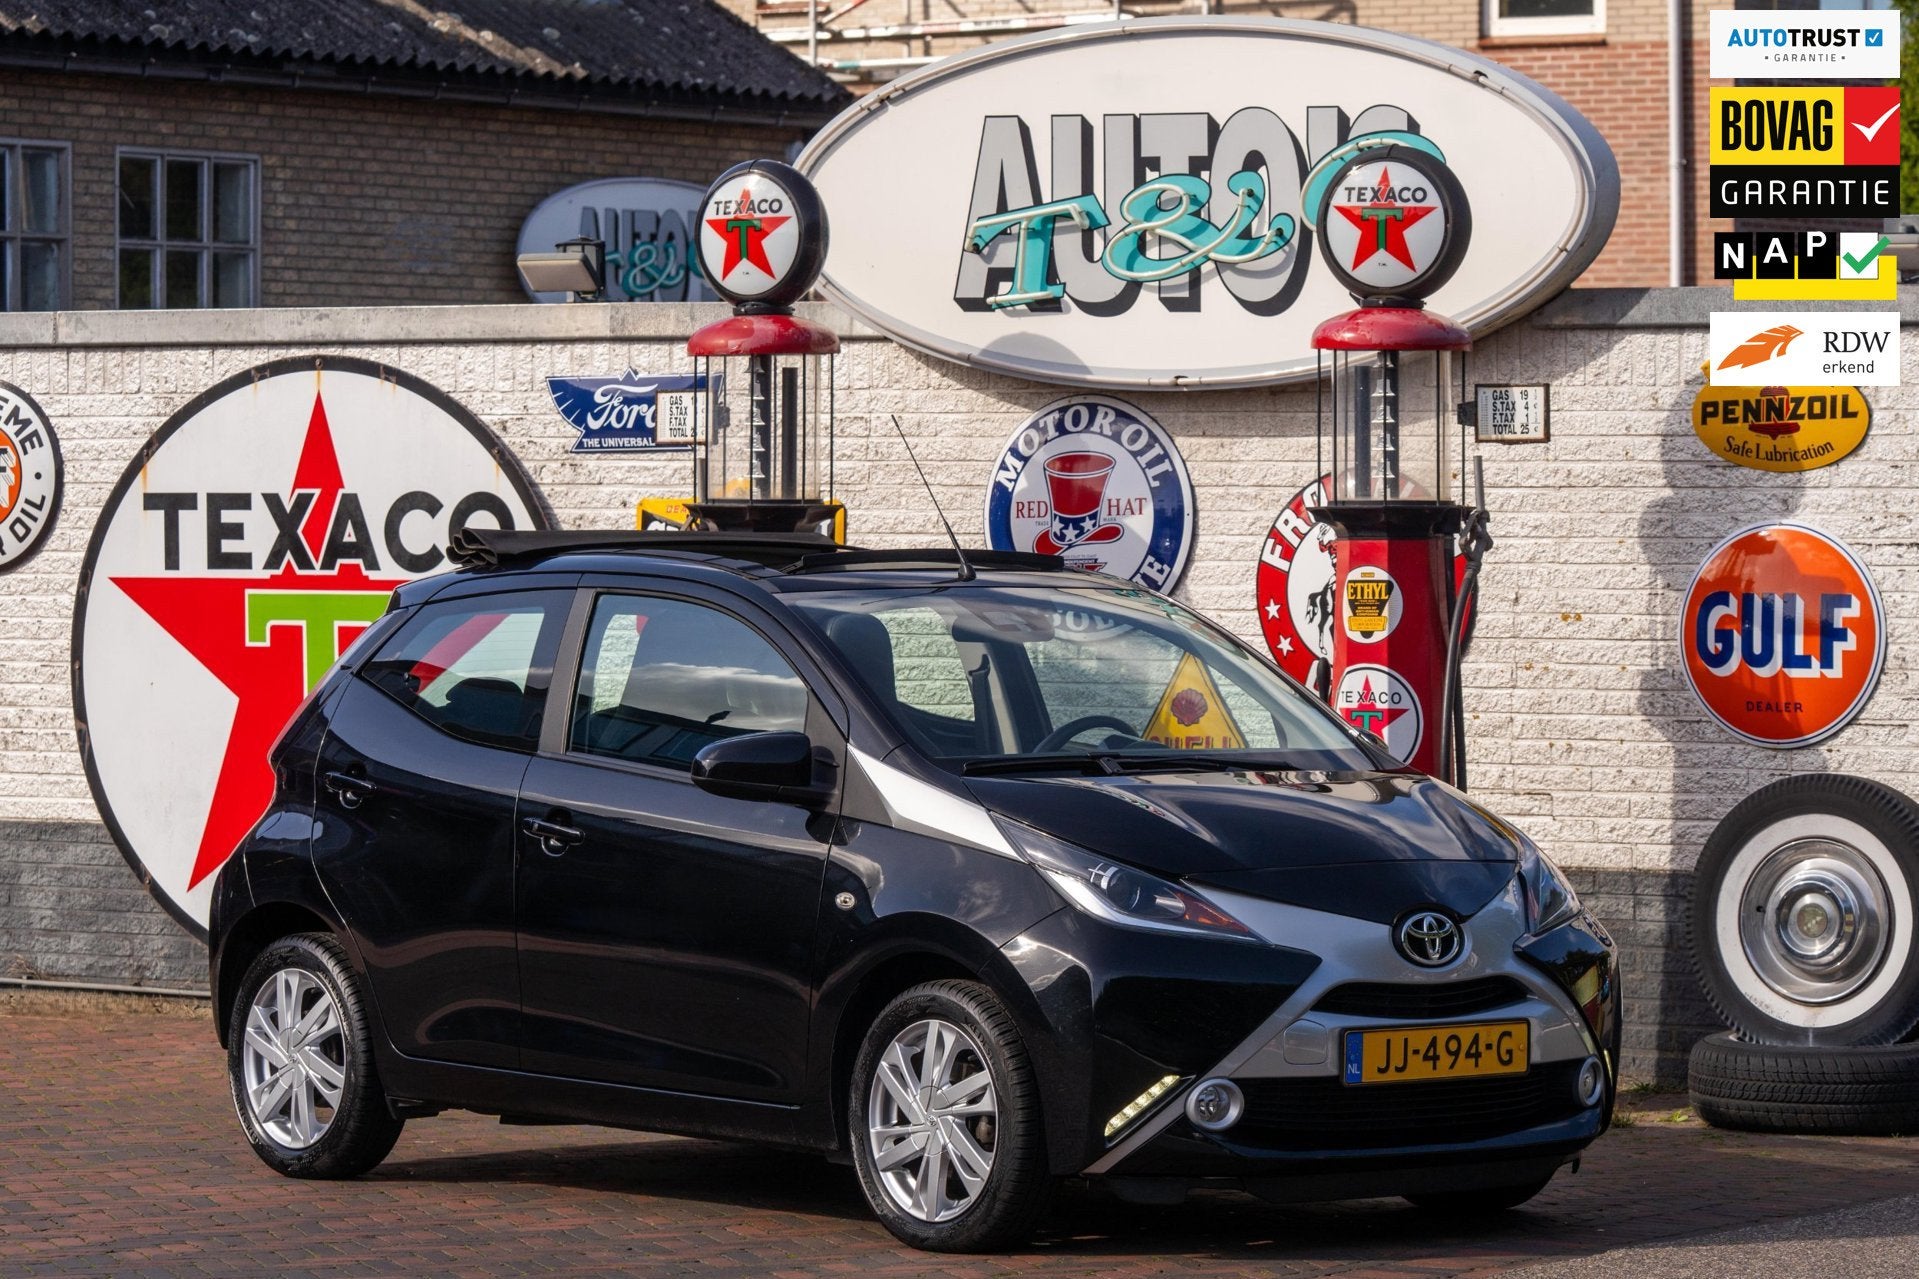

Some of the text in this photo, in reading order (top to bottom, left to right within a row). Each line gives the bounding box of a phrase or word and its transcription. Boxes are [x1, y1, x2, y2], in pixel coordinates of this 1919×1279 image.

[1344, 186, 1428, 203] TEXACO
[714, 198, 783, 215] TEXACO
[954, 104, 1420, 318] AUTO'
[669, 395, 683, 406] GAS
[1492, 389, 1509, 400] GAS
[1520, 389, 1529, 400] 19
[669, 406, 688, 416] S.TAX
[1492, 401, 1516, 412] S.TAX
[1524, 401, 1529, 412] 4
[1701, 394, 1860, 426] PENNZOIL
[669, 417, 687, 427] F.TAX
[1492, 412, 1515, 424] F.TAX
[669, 428, 688, 438] TOTAL
[1492, 424, 1517, 435] TOTAL
[1520, 424, 1530, 435] 25
[582, 437, 656, 448] THE UNIVERSAL
[996, 404, 1173, 492] MOTOR OIL
[1724, 435, 1835, 462] Safe Lubrication
[1015, 497, 1147, 519] RED HAT
[9, 494, 46, 544] OIL
[143, 491, 516, 573] TEXACO
[1347, 582, 1389, 600] ETHYL
[1696, 591, 1861, 678] GULF
[1746, 701, 1804, 713] DEALER
[1376, 1030, 1514, 1075] JJ-494-G
[1347, 1063, 1360, 1074] NL
